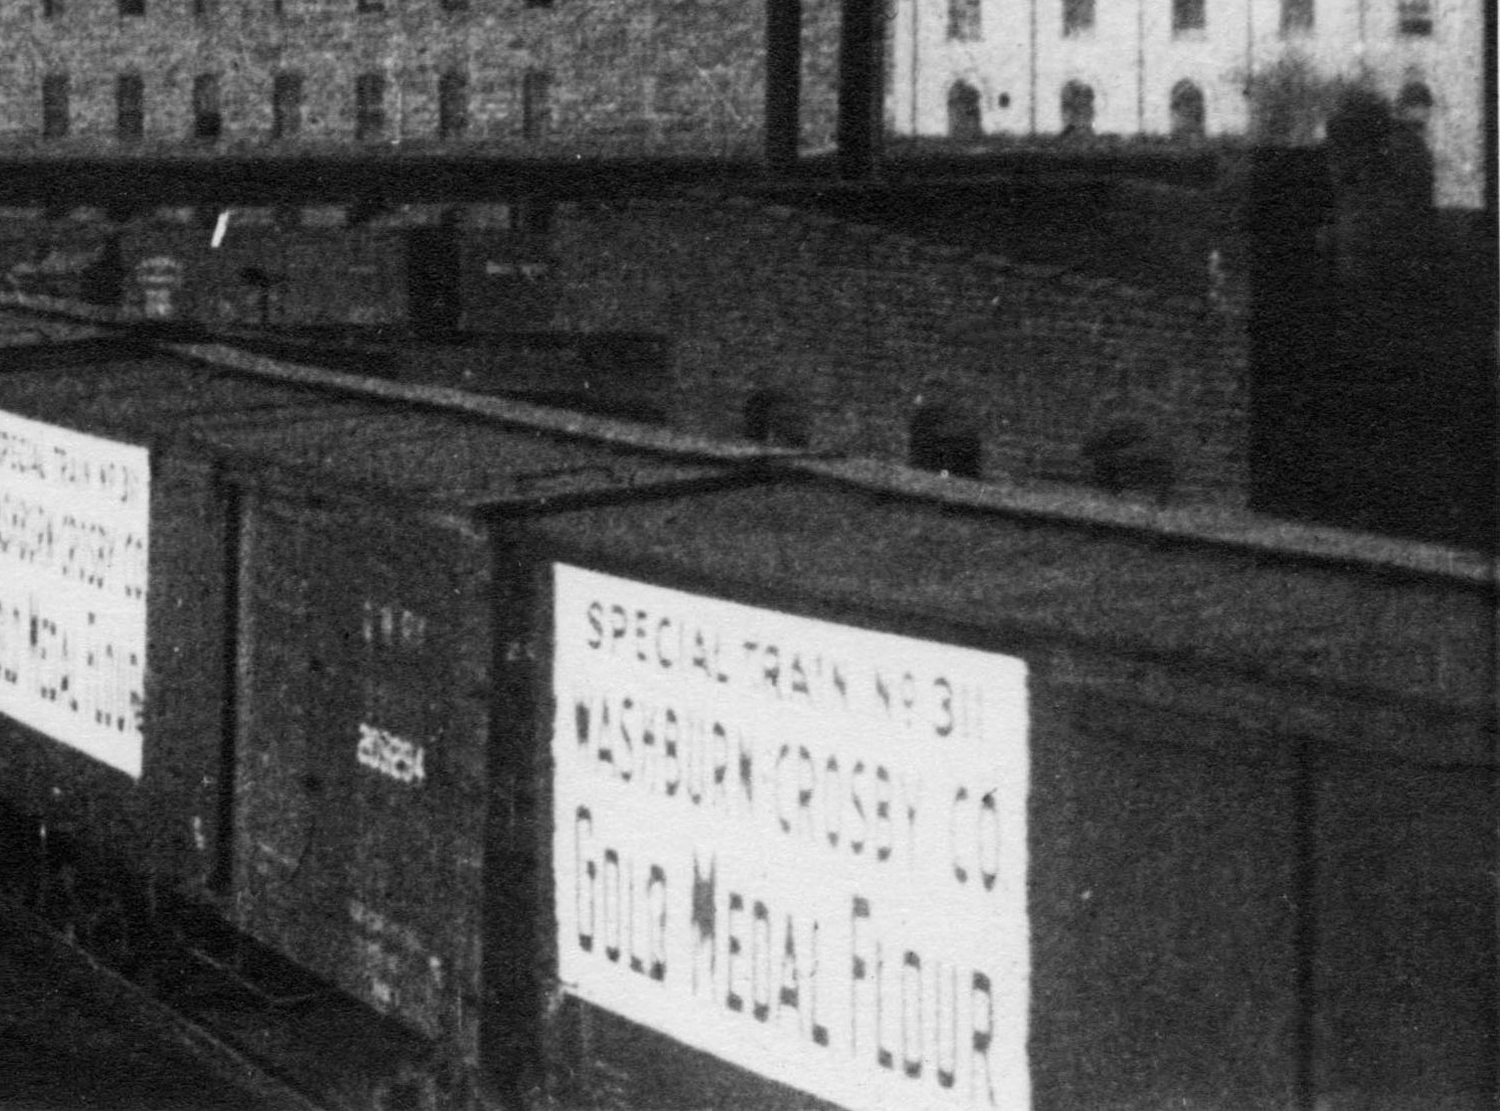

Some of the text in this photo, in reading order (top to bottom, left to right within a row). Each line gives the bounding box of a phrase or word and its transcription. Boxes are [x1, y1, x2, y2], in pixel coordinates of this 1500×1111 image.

[587, 600, 729, 683] SPECIAL
[743, 640, 850, 710] TRAIN
[575, 805, 667, 982] GOLD
[692, 851, 830, 1047] MEDAL
[851, 895, 998, 1107] FLOUR
